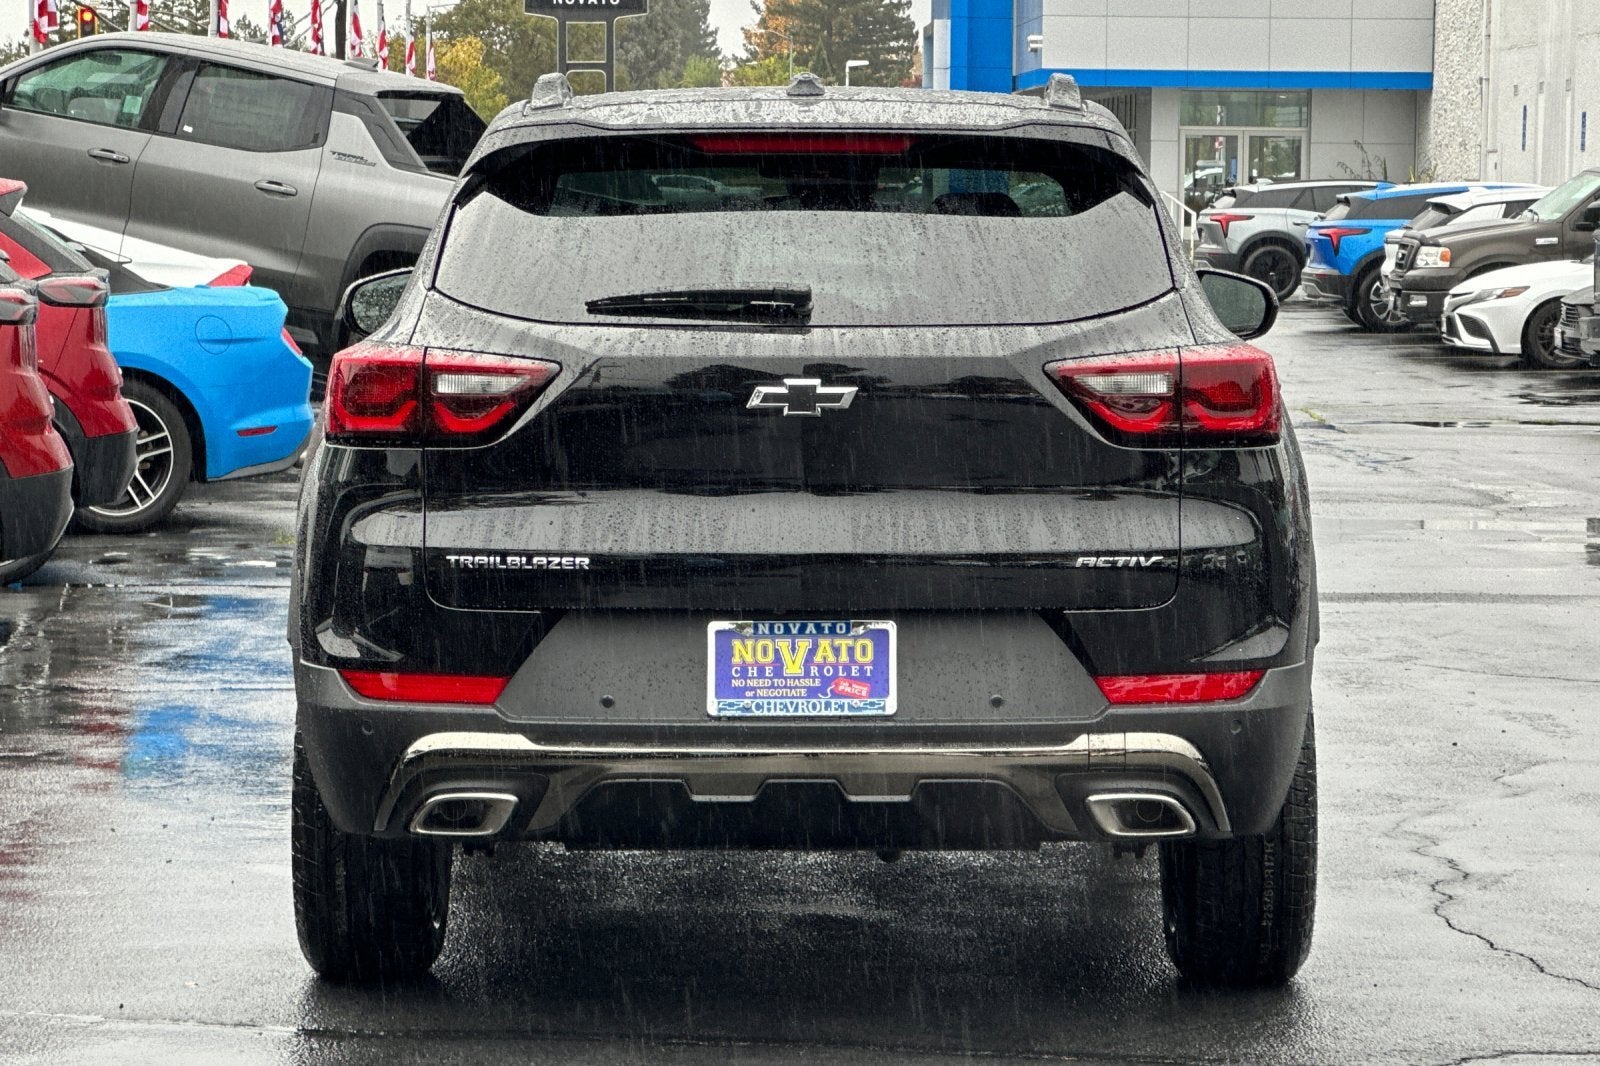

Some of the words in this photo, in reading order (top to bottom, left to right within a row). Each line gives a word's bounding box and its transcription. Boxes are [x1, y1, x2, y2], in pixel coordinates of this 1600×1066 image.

[446, 555, 590, 570] TRAILBLAZER
[1075, 556, 1164, 567] ACTIV
[757, 622, 847, 635] NOVATO
[731, 638, 875, 677] NOVATO
[731, 678, 745, 687] NO
[747, 679, 771, 687] NEED
[772, 679, 786, 687] TO
[787, 679, 821, 687] HASSLE
[756, 688, 808, 697] NEGOTIATE
[838, 684, 868, 697] PRICE
[751, 700, 851, 714] CHEVROLET
